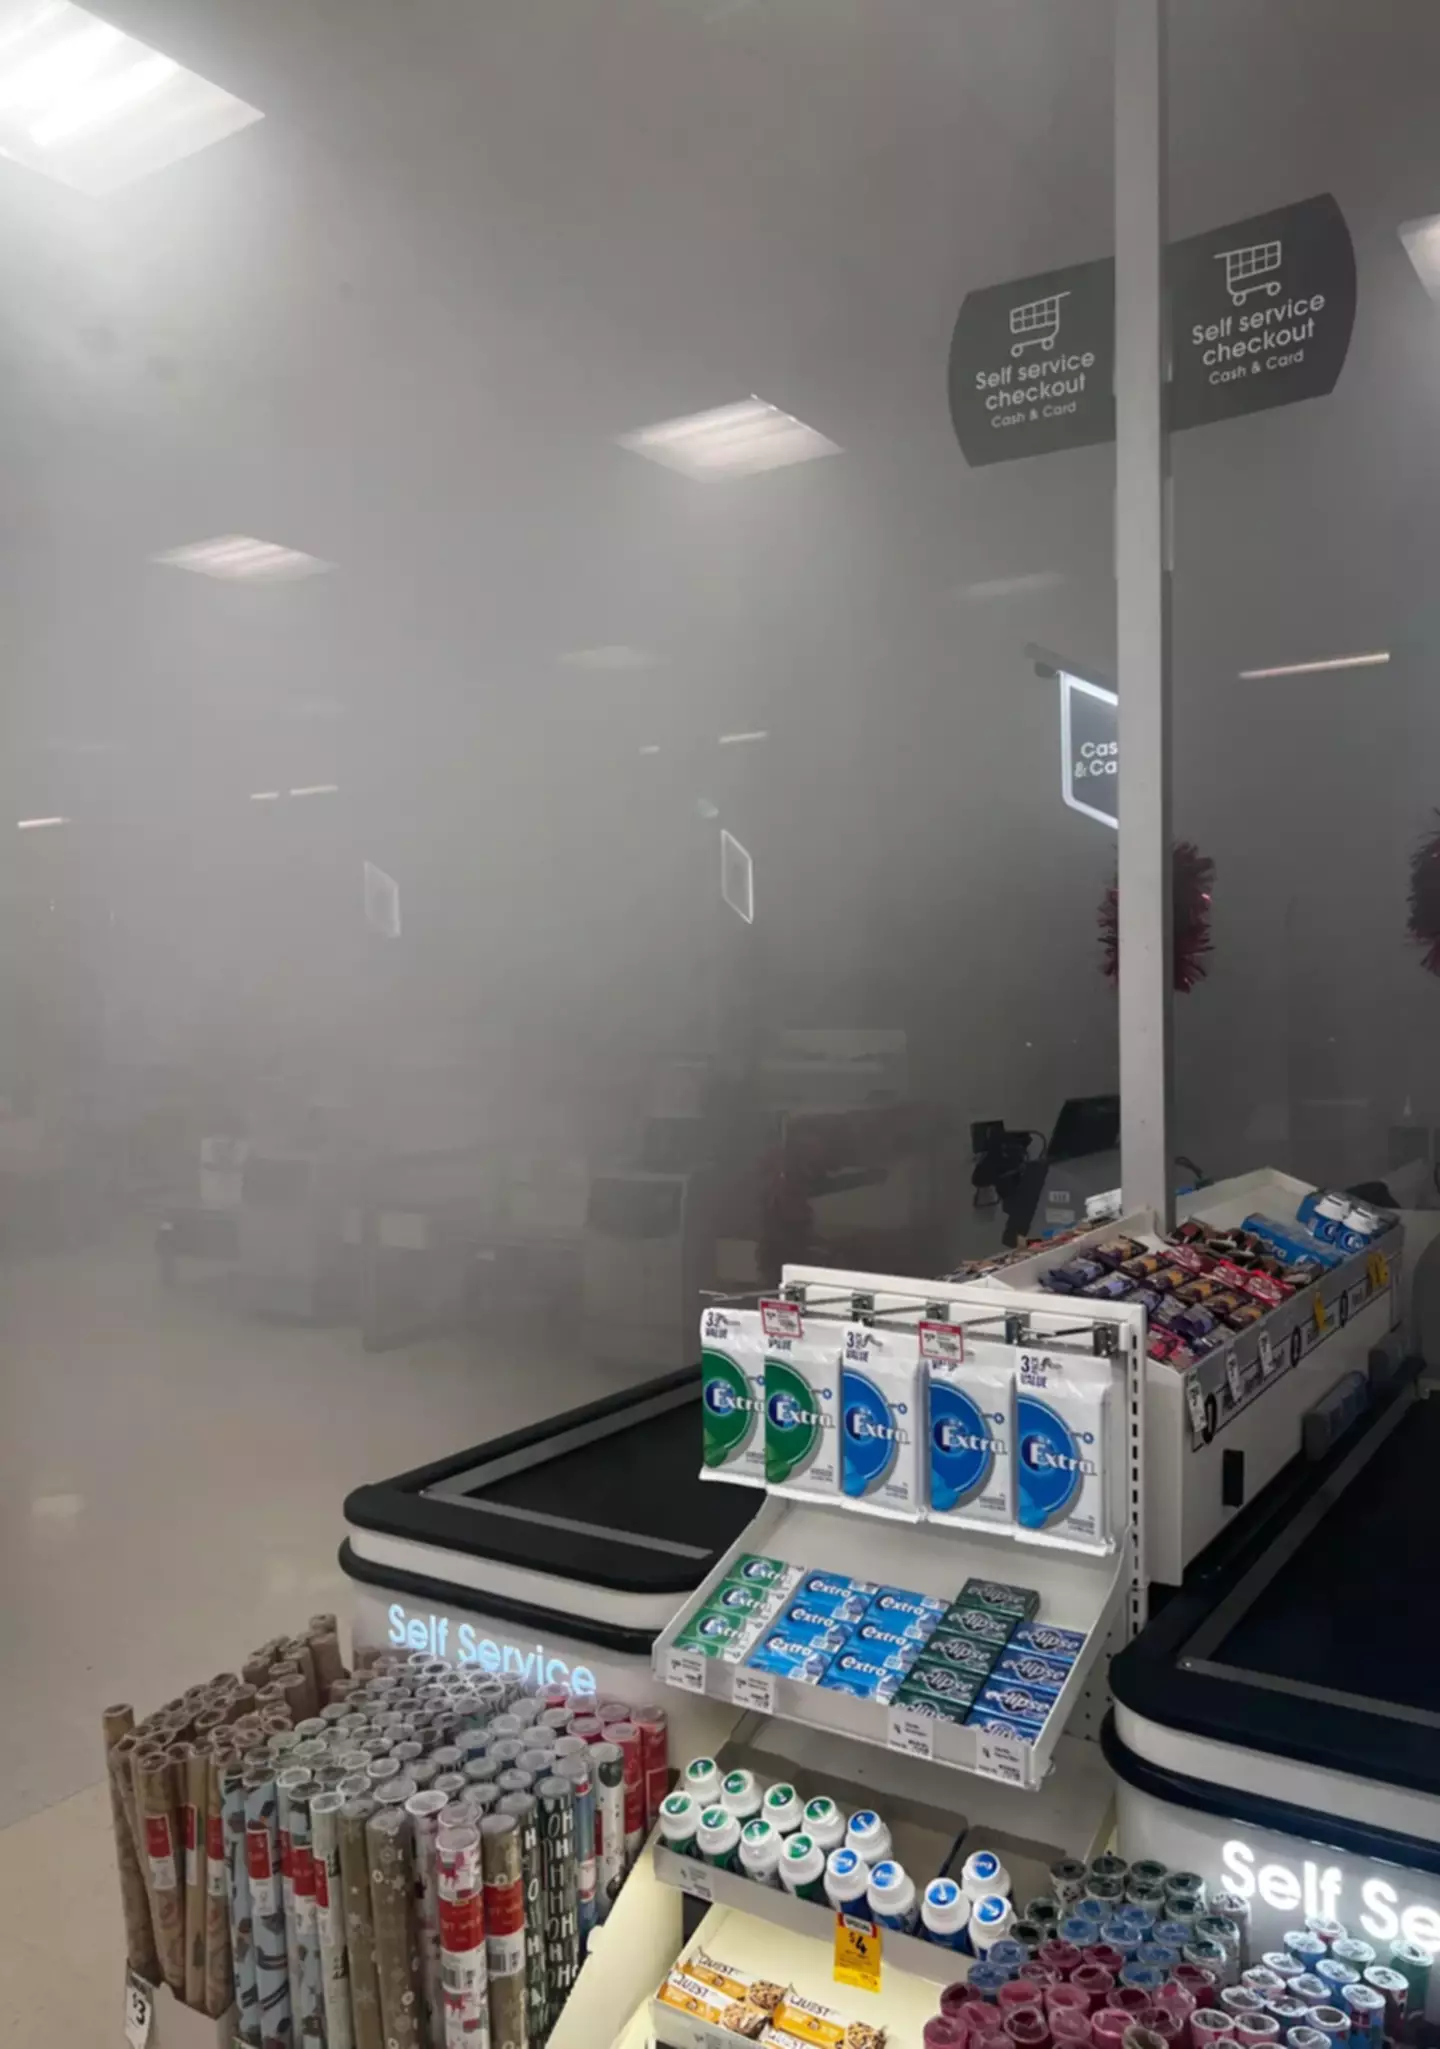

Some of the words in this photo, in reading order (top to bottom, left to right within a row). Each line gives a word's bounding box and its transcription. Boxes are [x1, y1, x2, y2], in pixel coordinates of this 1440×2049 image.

[1192, 316, 1232, 345] Self
[1239, 294, 1325, 332] service
[1203, 317, 1315, 366] checkout
[976, 364, 1012, 390] Self
[1017, 352, 1095, 381] service
[1209, 365, 1246, 385] Cash
[1251, 360, 1261, 375] &
[1266, 348, 1304, 370] Card
[985, 371, 1086, 411] checkout
[990, 411, 1026, 428] Cash
[1042, 400, 1077, 418] Card
[1074, 761, 1087, 778] &
[776, 1400, 836, 1430] Extra
[853, 1413, 911, 1446] Extra
[941, 1424, 1009, 1456] Extra
[1029, 1441, 1099, 1477] Extra
[387, 1603, 450, 1658] Self
[457, 1622, 598, 1697] Service
[1220, 1839, 1343, 1921] Self
